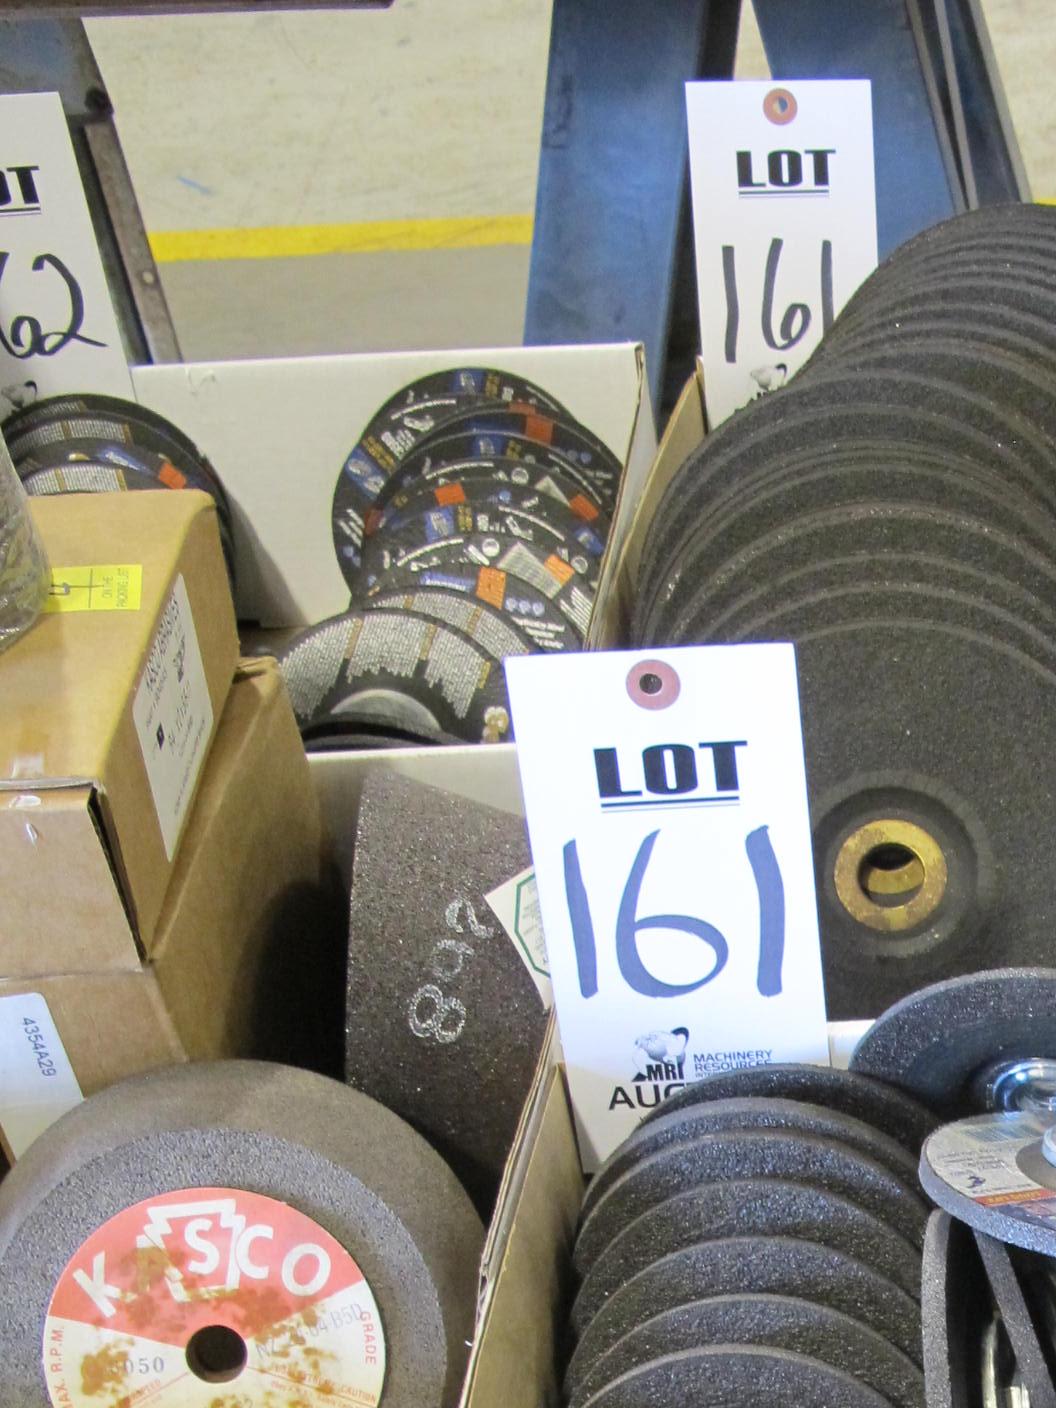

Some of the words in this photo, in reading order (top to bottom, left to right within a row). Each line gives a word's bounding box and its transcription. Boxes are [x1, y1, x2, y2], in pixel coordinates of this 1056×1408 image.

[735, 148, 836, 188] LOT
[721, 237, 833, 364] 161
[593, 740, 748, 798] LOT
[563, 826, 786, 999] 161
[20, 1014, 57, 1078] 4354A29
[646, 1063, 685, 1082] MRI
[693, 1050, 773, 1064] MACHINERY
[360, 1311, 377, 1366] GRADE
